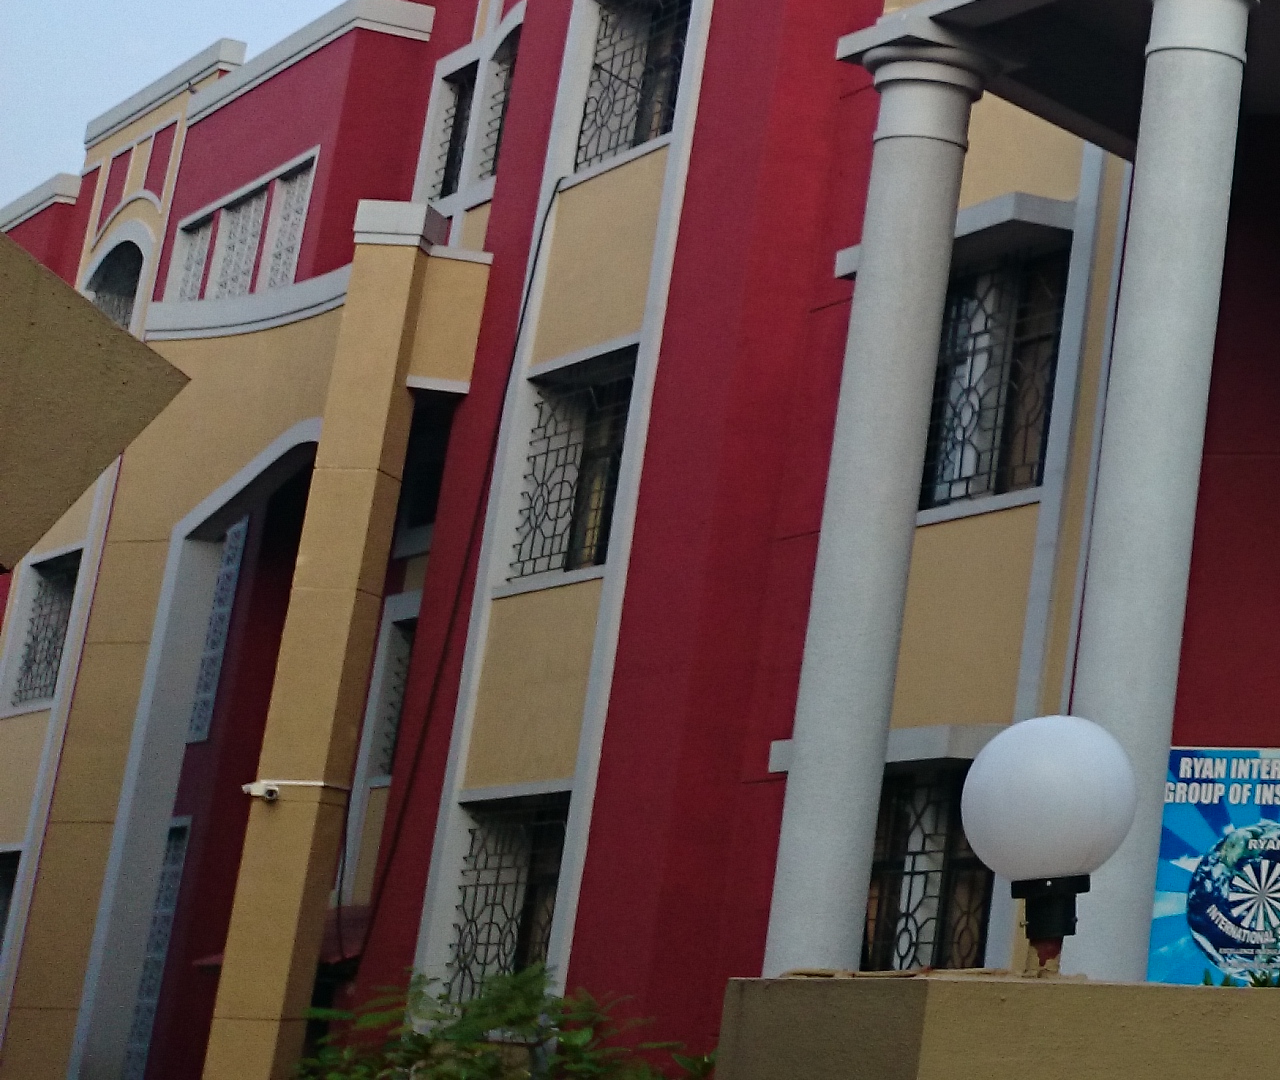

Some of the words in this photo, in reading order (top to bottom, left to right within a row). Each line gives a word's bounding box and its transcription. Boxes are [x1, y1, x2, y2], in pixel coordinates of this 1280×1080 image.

[1179, 757, 1227, 779] RYAN
[1164, 781, 1225, 804] GROUP
[1228, 783, 1252, 805] OF
[1206, 904, 1277, 944] INTERNATIONAL
